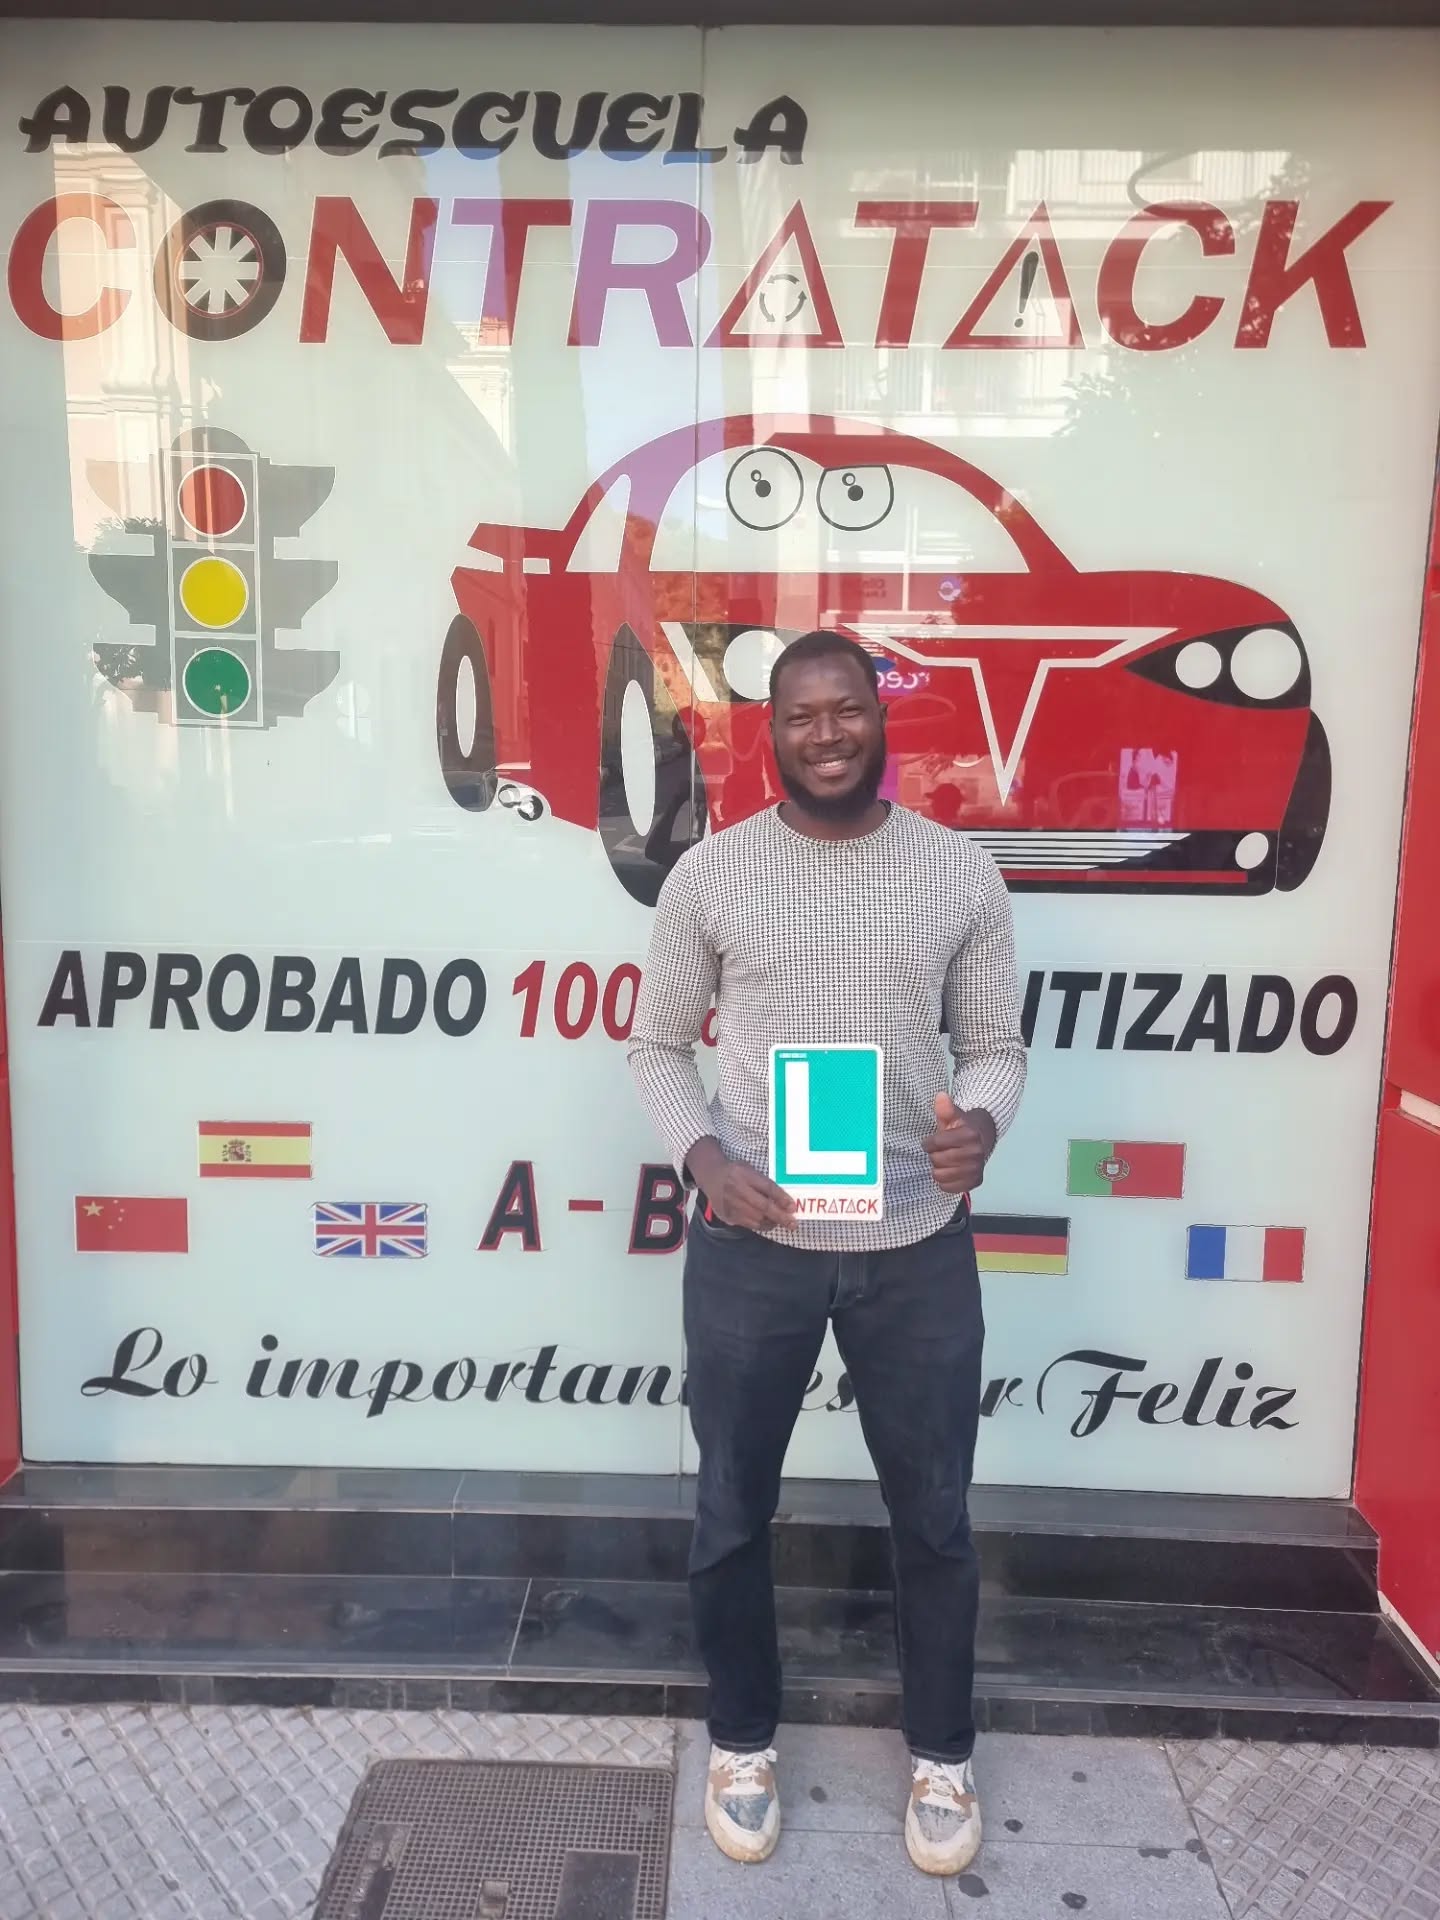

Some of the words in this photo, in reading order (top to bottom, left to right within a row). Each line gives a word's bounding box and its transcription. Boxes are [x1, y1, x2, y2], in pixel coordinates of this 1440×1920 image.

[18, 84, 809, 166] AUTOESCUELA
[7, 191, 1395, 352] CONTRATACK
[37, 949, 487, 1037] APROBADO
[512, 960, 718, 1047] 100
[785, 1061, 867, 1175] L
[477, 1160, 545, 1252] A
[627, 1163, 689, 1254] B
[795, 1198, 879, 1214] NTRATACK
[80, 1326, 218, 1398] Lo
[245, 1333, 688, 1419] importan
[1036, 1348, 1301, 1439] Feliz
